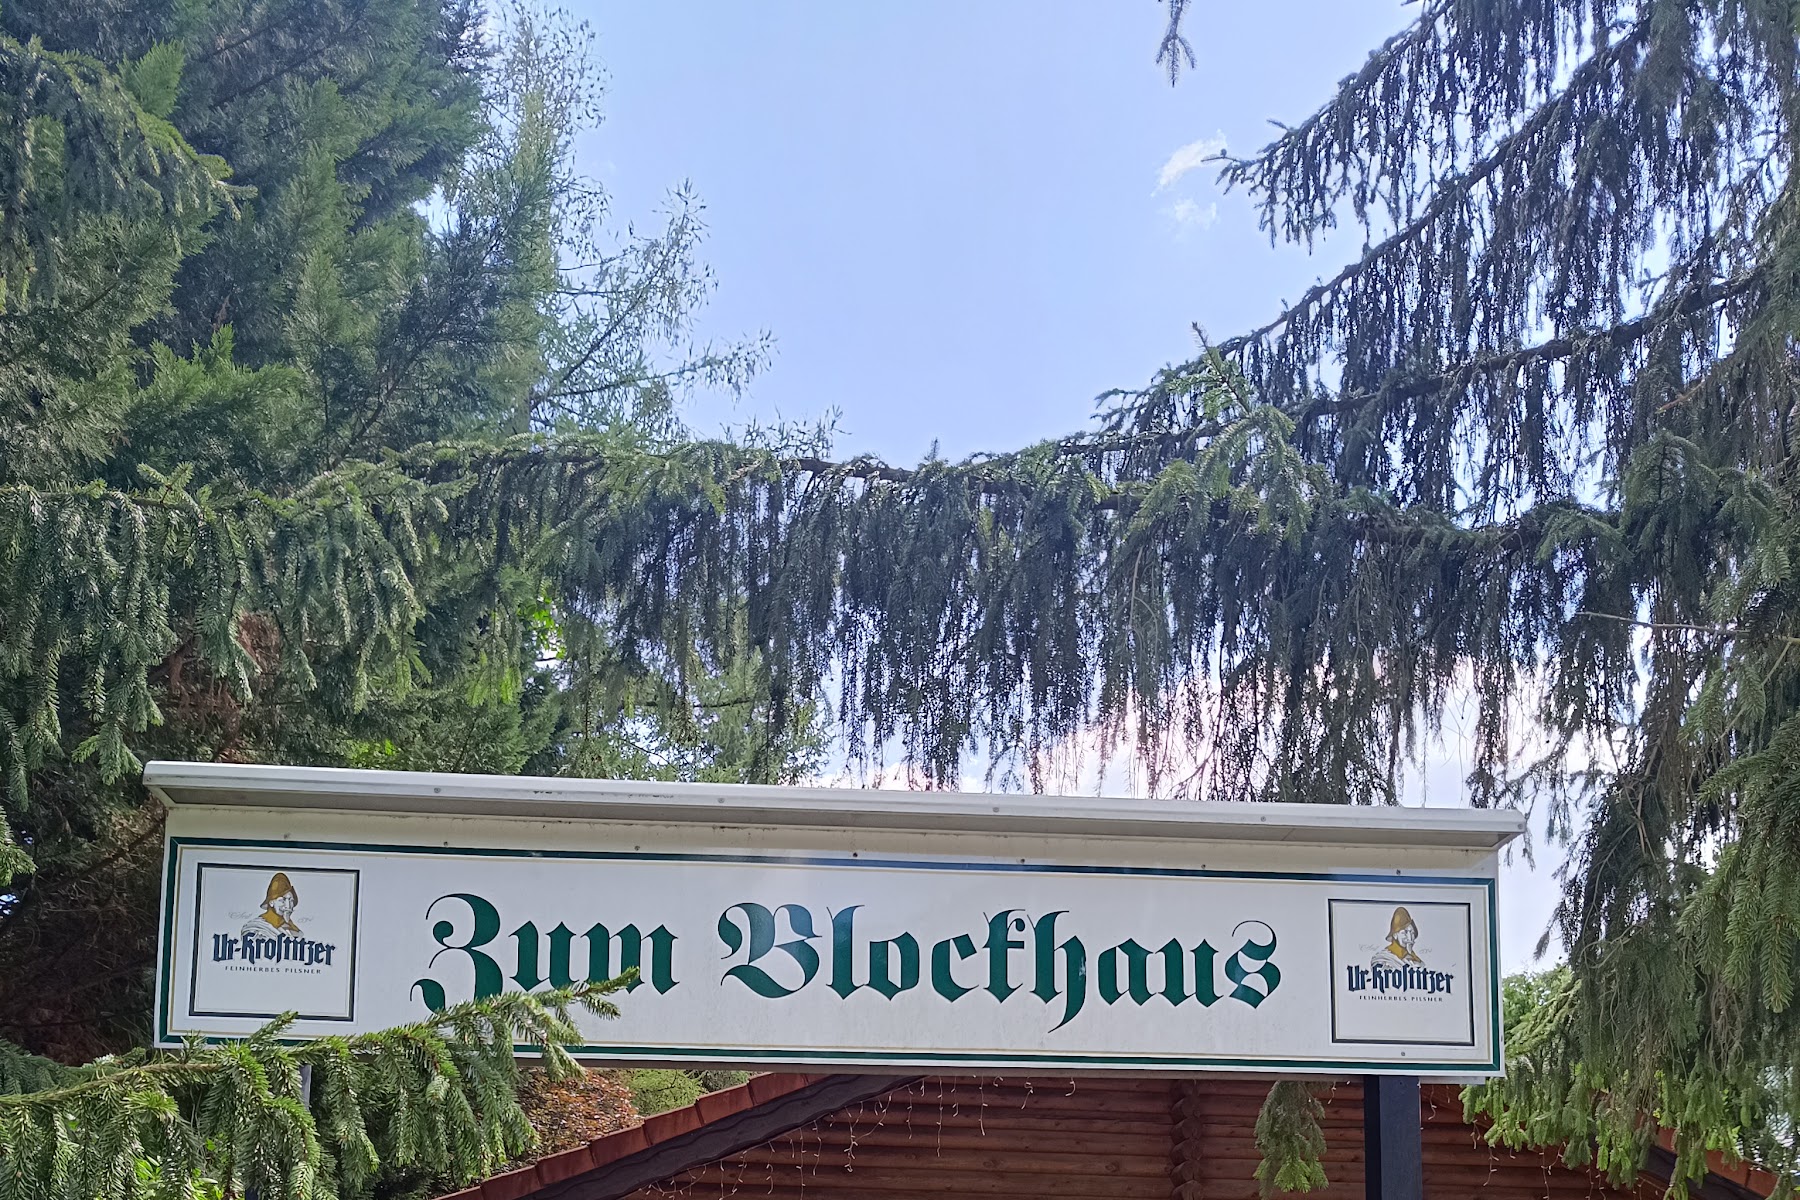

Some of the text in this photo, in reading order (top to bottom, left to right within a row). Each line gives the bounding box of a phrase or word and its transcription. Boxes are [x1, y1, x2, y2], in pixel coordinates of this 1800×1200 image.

[213, 933, 336, 966] Ur-Krostitzer
[410, 893, 1281, 1032] Zum Blockhaus
[1347, 964, 1454, 994] Ur-Krostitzer
